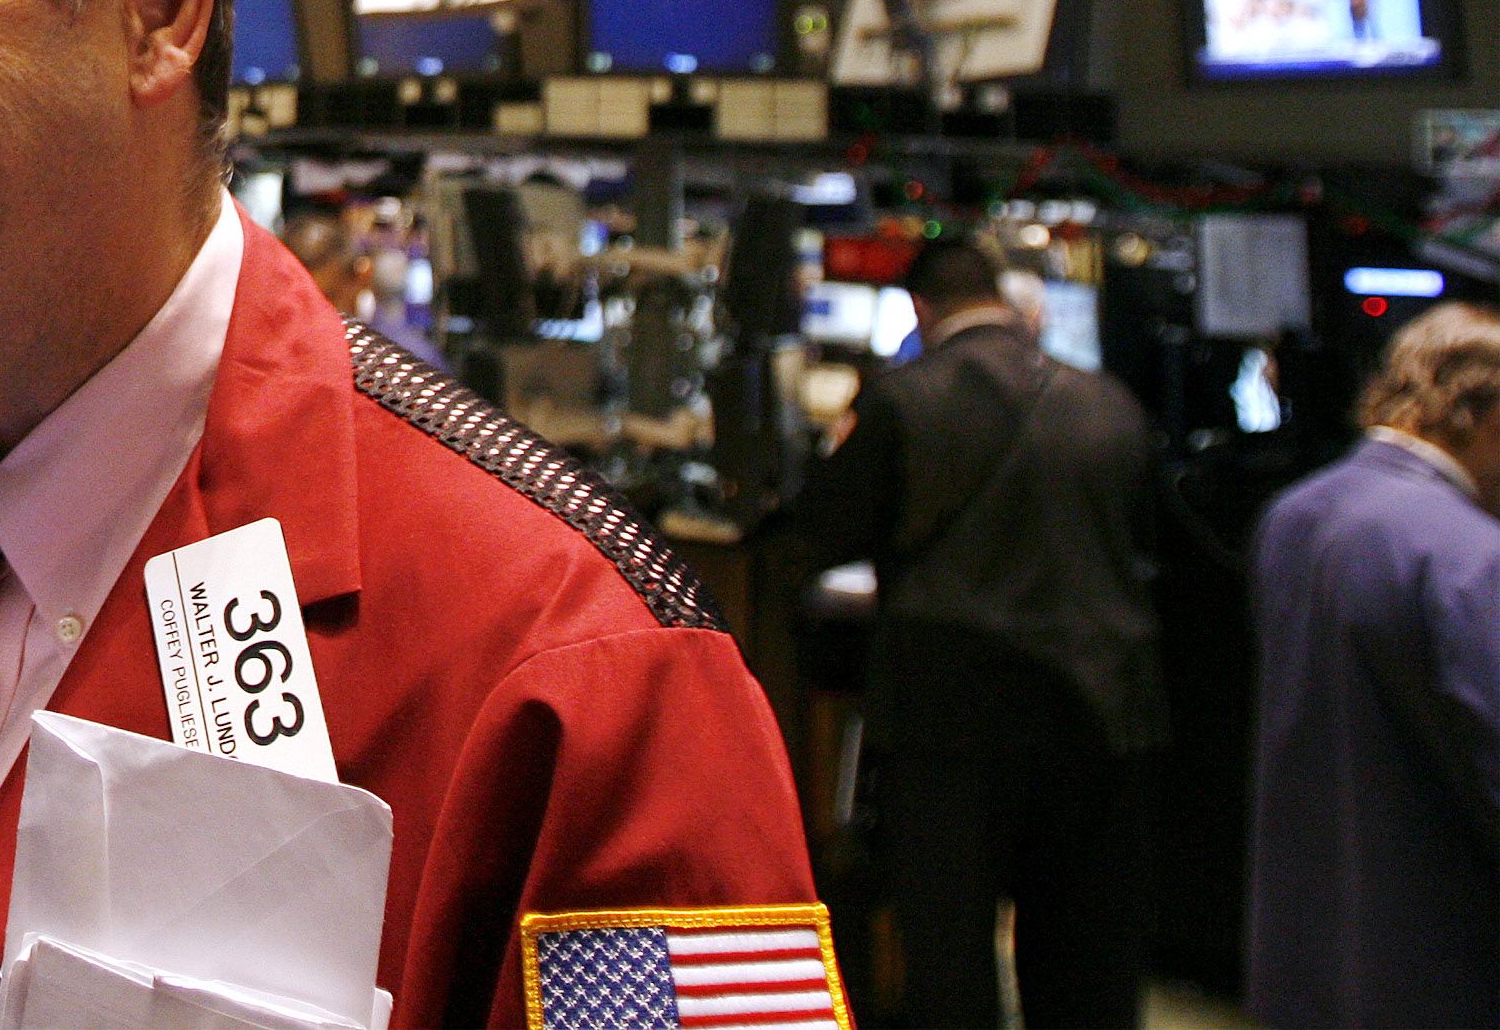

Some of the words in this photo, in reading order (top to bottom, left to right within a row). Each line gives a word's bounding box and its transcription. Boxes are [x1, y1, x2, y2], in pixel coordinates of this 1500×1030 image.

[160, 599, 183, 660] COFFEY
[172, 665, 199, 748] PUGLIESE
[190, 582, 220, 668] WALTER
[206, 672, 224, 693] J.
[224, 590, 304, 746] 363
